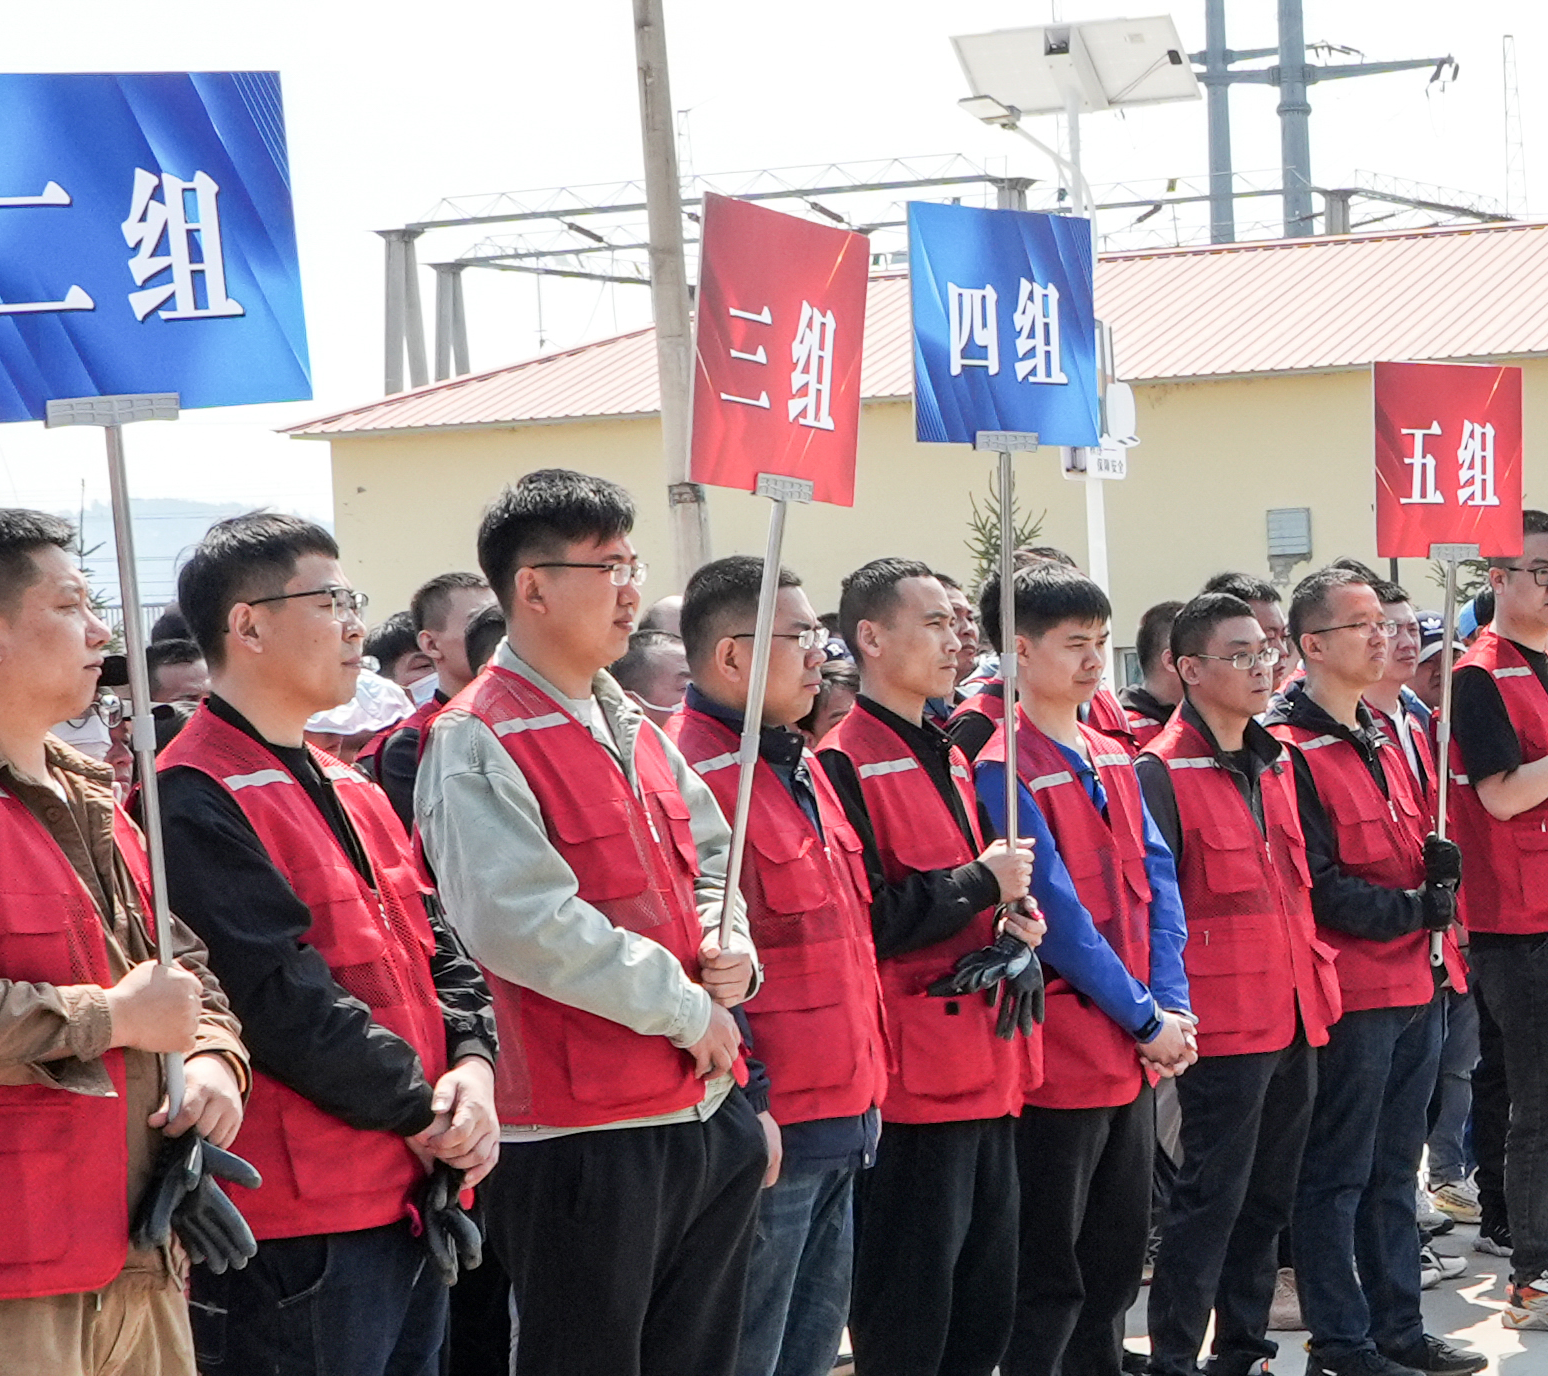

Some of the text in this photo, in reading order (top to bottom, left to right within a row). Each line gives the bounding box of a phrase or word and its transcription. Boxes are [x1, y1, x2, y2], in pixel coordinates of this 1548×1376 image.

[720, 299, 838, 432] 三组
[947, 277, 1069, 385] 四组
[1399, 420, 1500, 506] 五组
